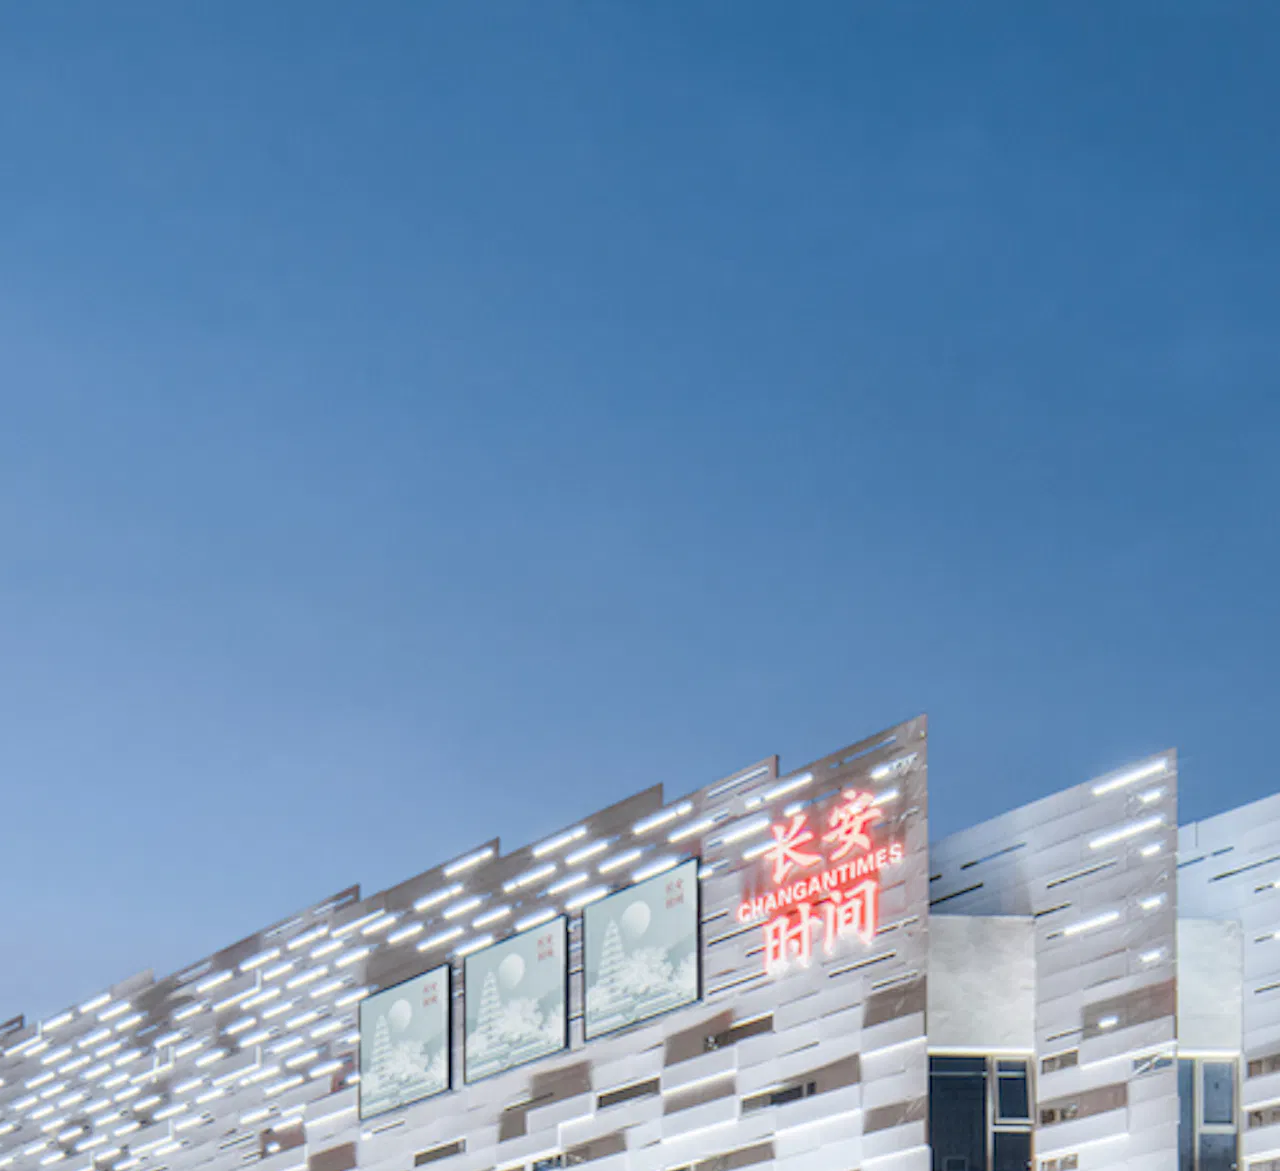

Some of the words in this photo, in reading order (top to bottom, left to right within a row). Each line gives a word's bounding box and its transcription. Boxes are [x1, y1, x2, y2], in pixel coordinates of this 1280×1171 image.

[737, 843, 904, 923] CHANGANTIMES
[765, 789, 882, 883] 长安
[763, 879, 878, 977] 时间
